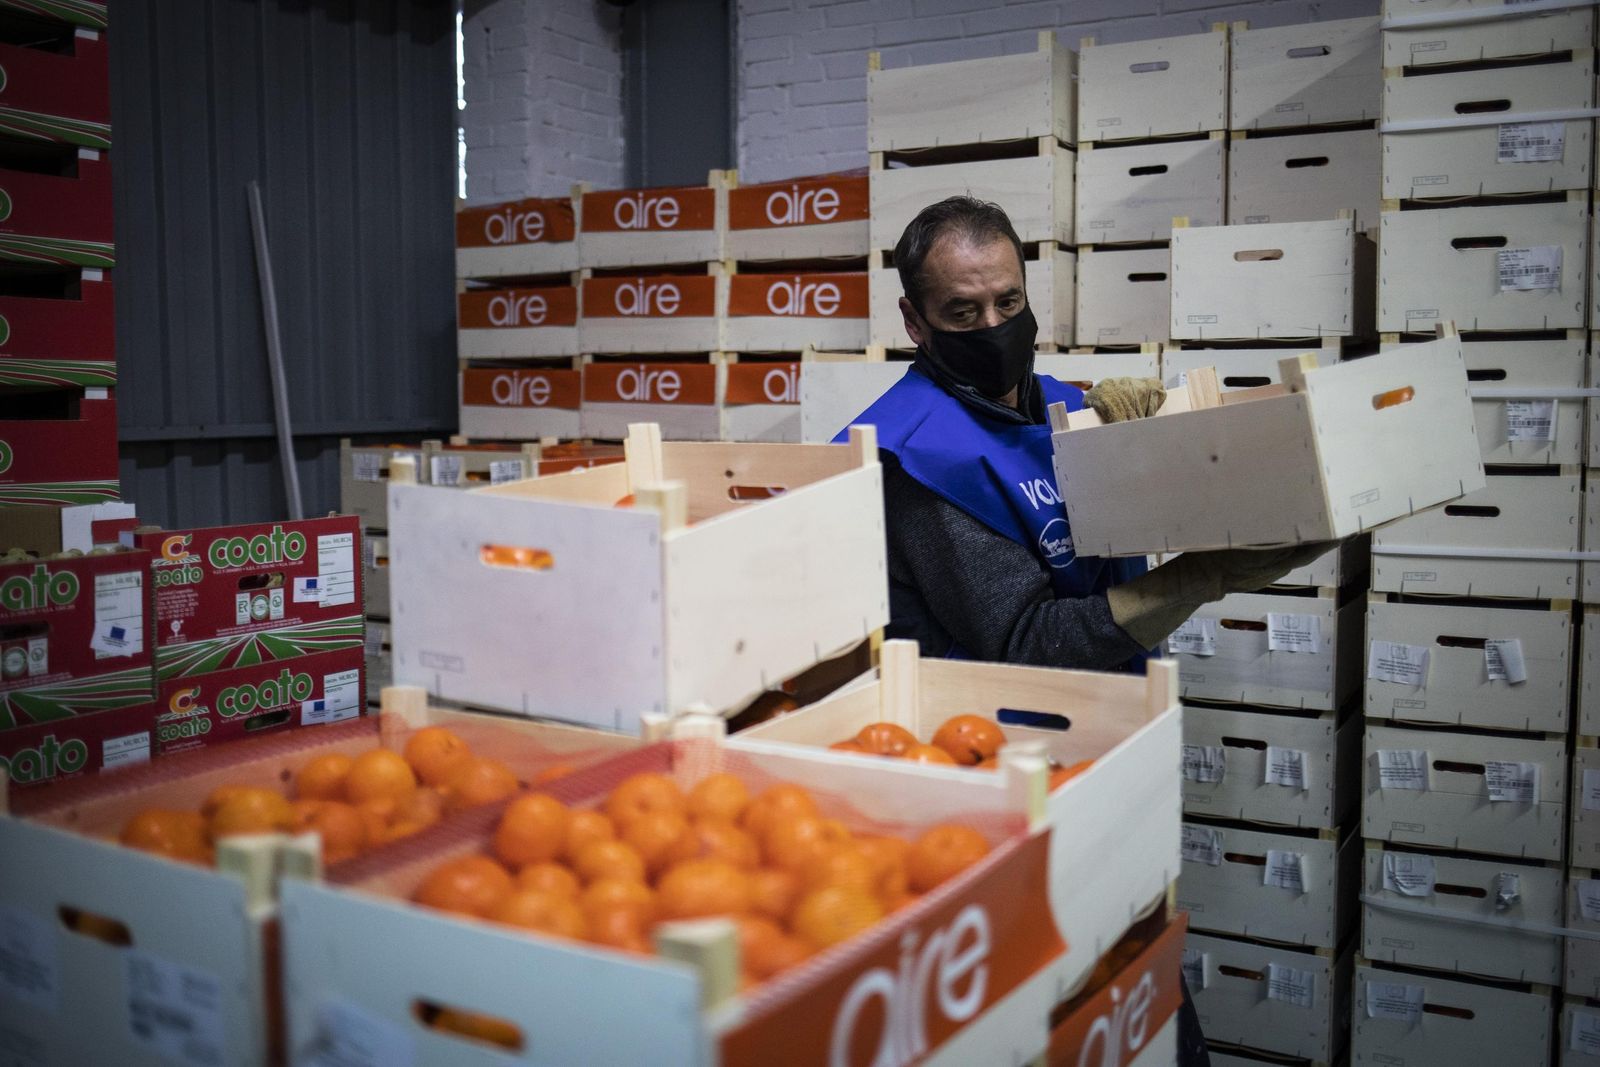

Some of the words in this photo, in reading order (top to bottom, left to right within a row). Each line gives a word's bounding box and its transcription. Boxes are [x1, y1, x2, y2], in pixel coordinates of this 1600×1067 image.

[614, 192, 679, 229] aire
[766, 184, 840, 225] aire
[485, 208, 544, 244] aire
[488, 291, 547, 327] aire
[615, 278, 680, 315] aire
[767, 277, 841, 316] aire
[492, 370, 551, 406] aire
[616, 364, 681, 402] aire
[765, 363, 801, 402] ai
[208, 525, 307, 569] coato
[216, 668, 313, 717] coato
[158, 716, 212, 741] coato
[828, 903, 991, 1067] aire
